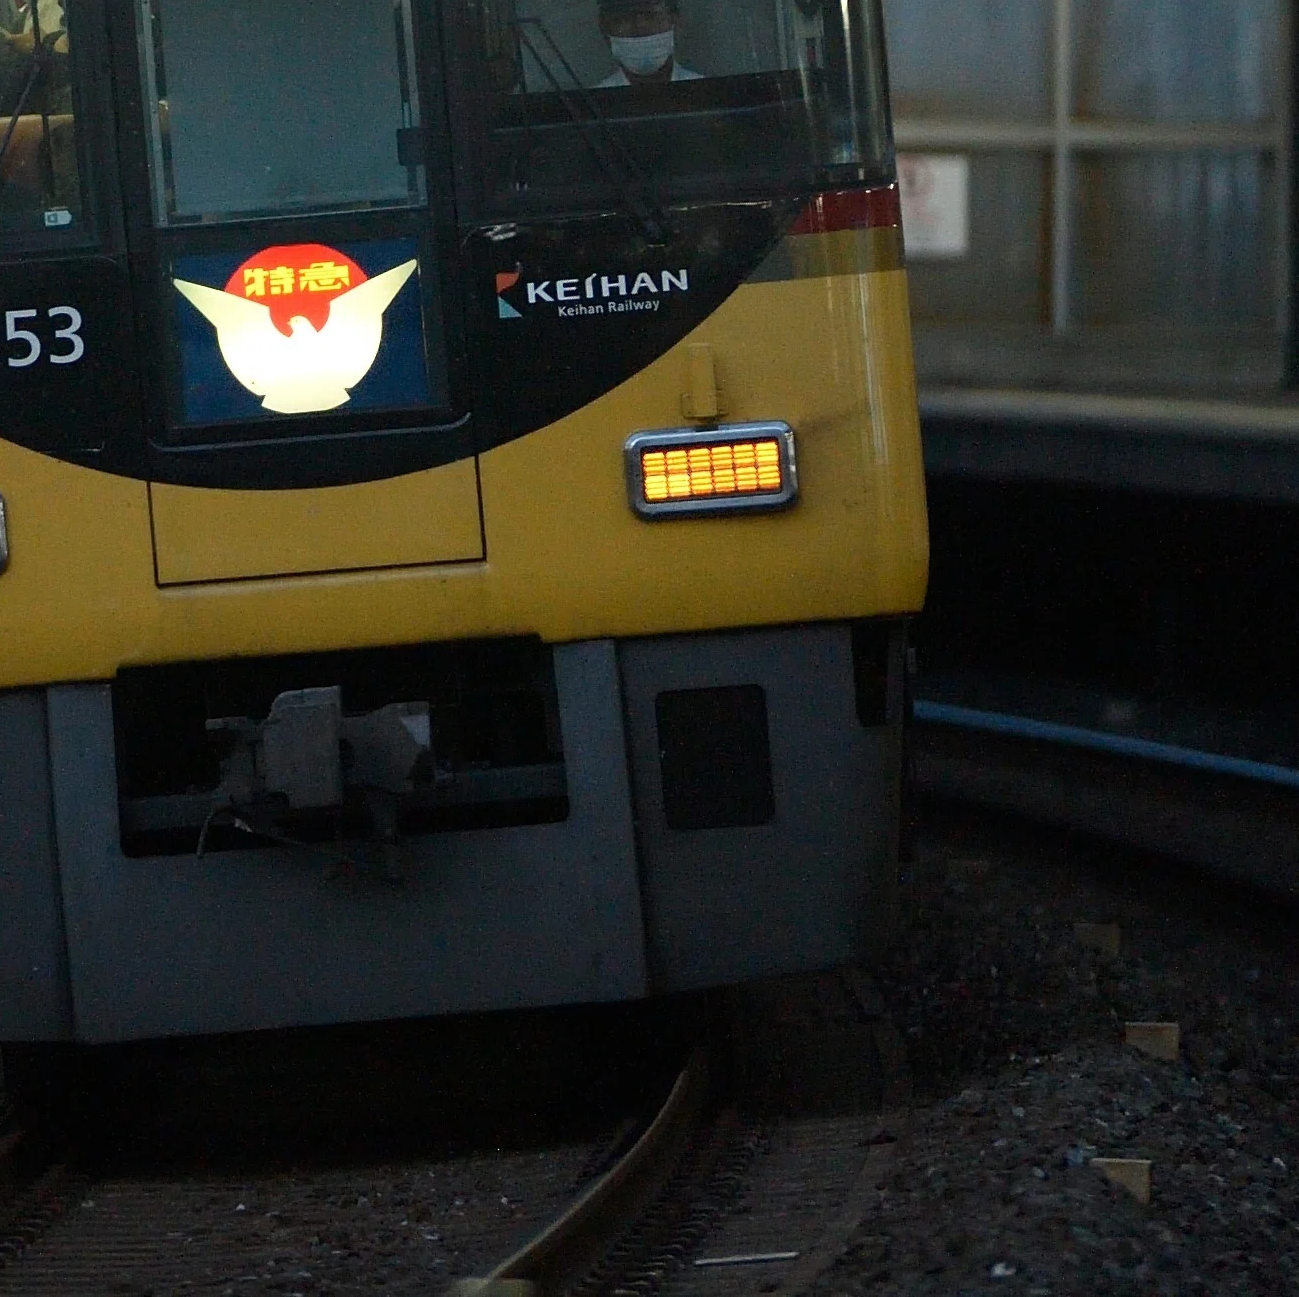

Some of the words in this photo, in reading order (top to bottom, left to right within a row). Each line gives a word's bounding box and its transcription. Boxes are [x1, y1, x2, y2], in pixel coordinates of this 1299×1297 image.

[243, 261, 350, 298] 特急
[526, 268, 689, 304] KEIHAN
[558, 304, 604, 318] Keihan
[608, 299, 661, 314] Railway
